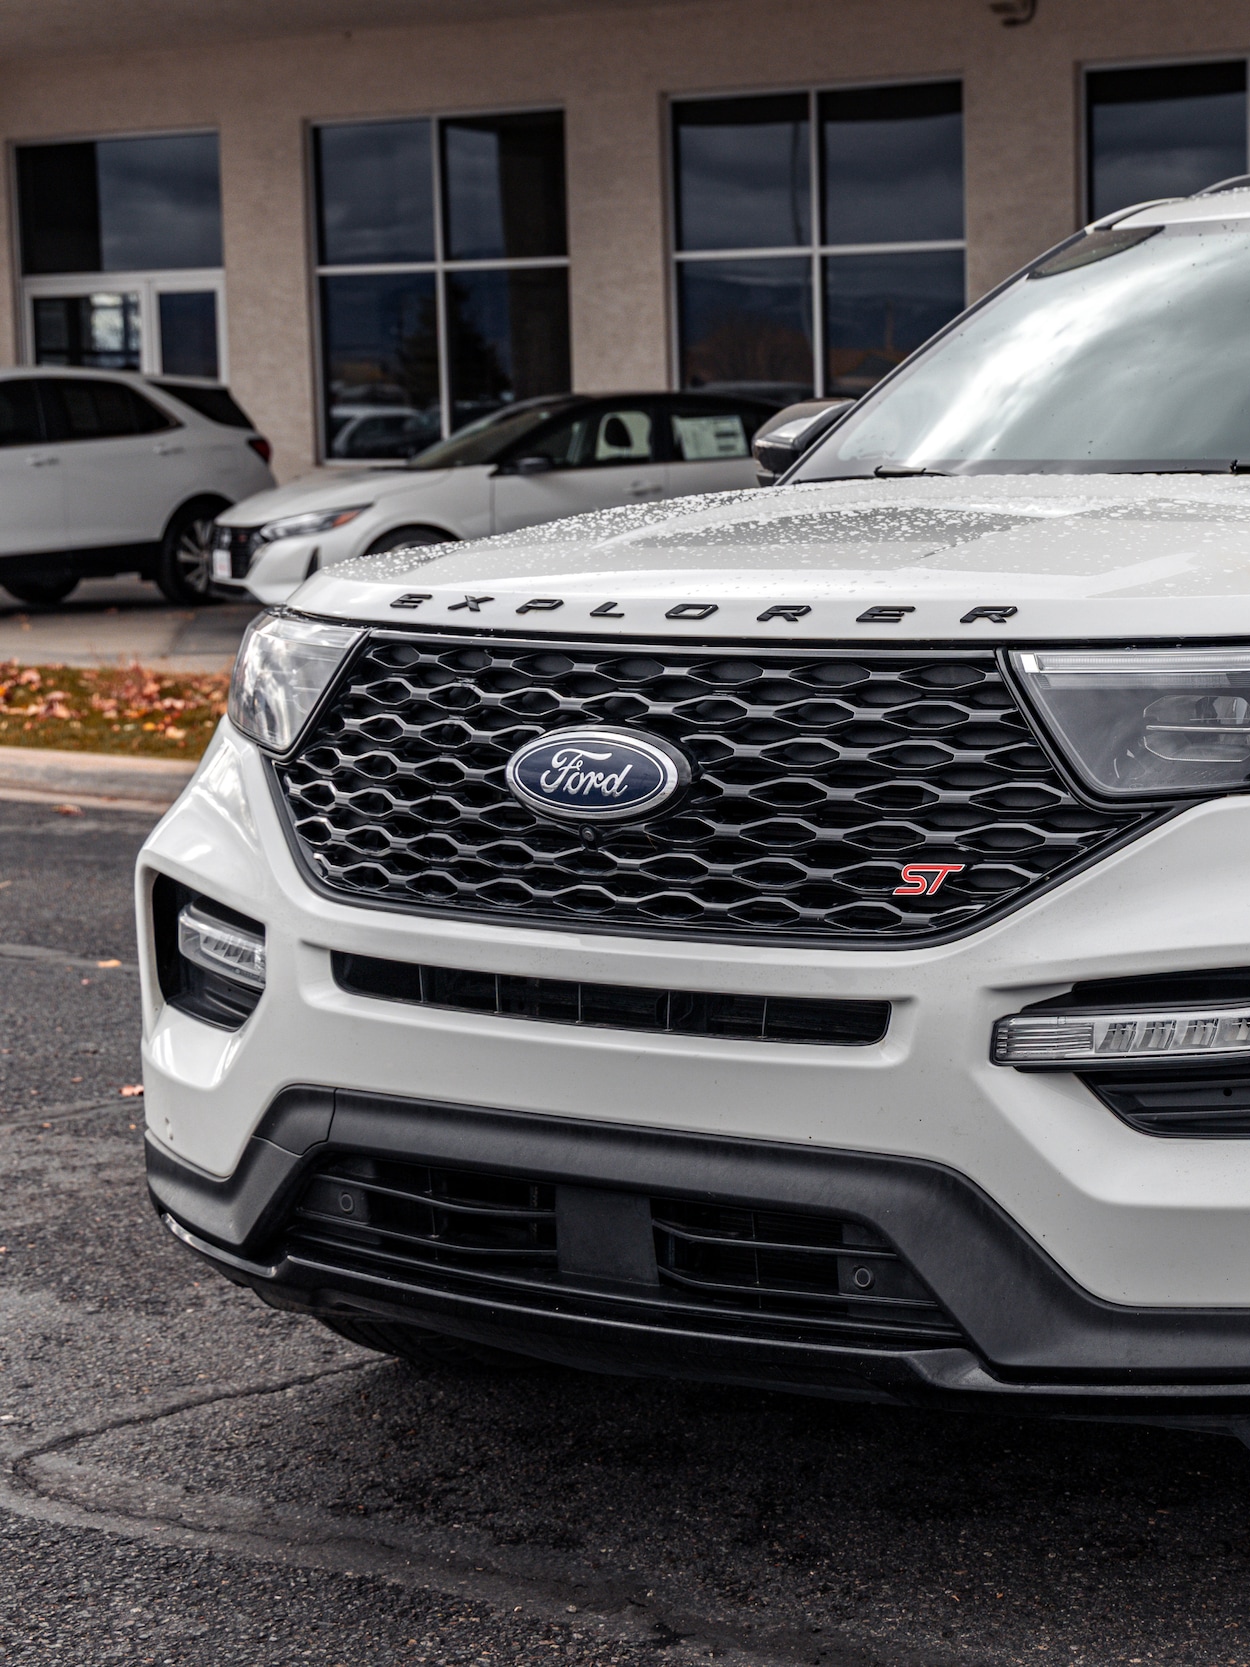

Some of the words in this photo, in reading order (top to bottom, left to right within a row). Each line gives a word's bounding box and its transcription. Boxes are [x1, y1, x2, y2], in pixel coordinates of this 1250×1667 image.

[390, 593, 1018, 624] EXPLORER
[541, 748, 633, 797] Ford
[893, 864, 966, 896] ST
